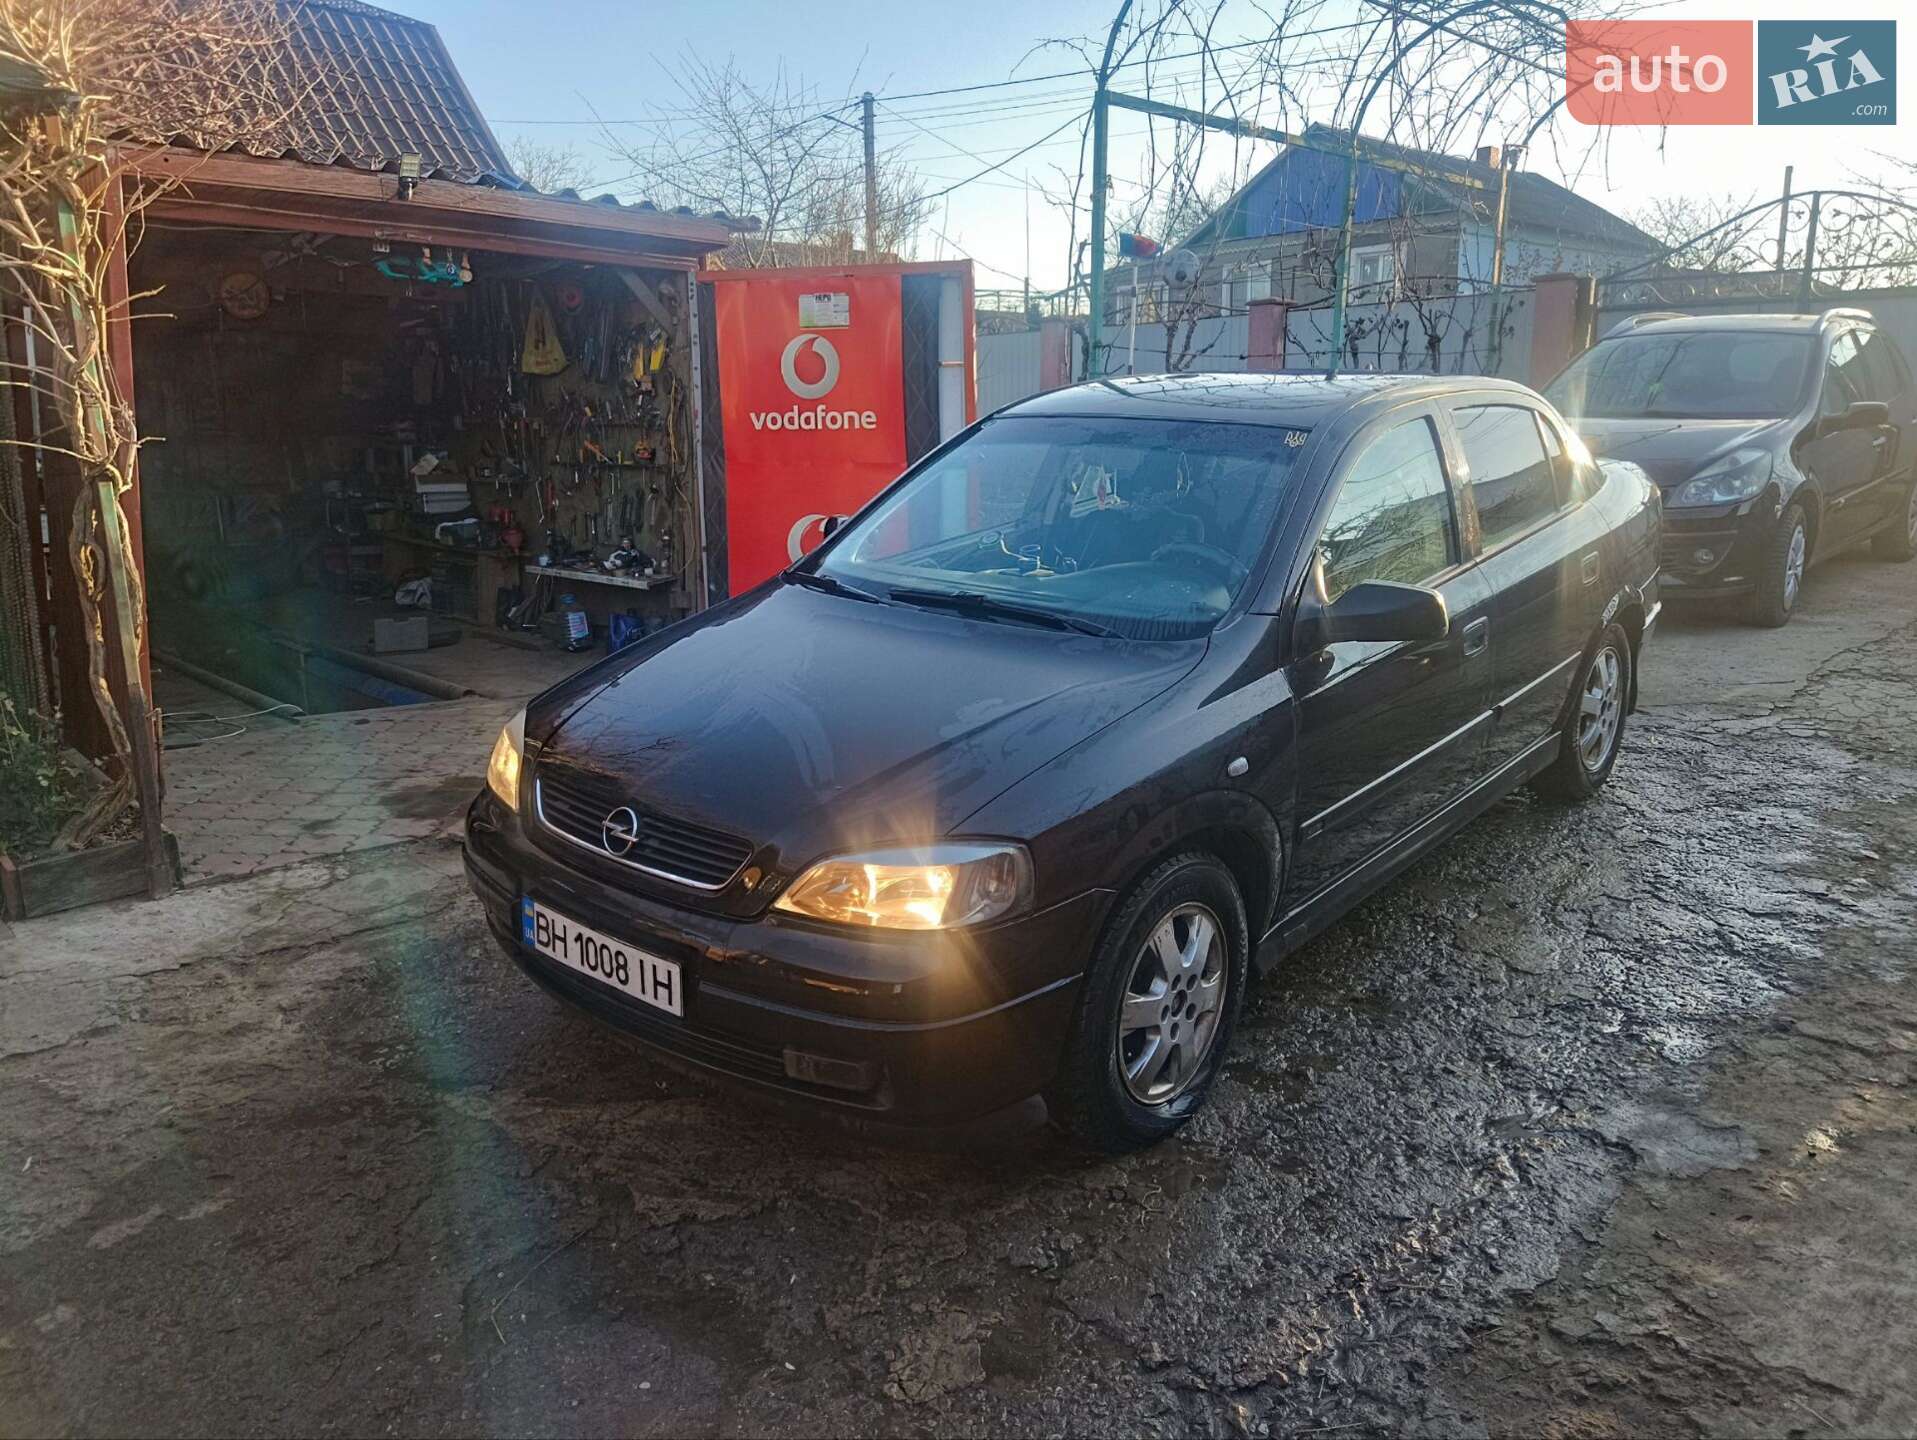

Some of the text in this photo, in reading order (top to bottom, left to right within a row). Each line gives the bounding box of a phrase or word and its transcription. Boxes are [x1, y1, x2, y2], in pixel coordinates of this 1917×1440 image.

[750, 405, 877, 431] vodafone
[535, 911, 673, 1006] BH 1008 IH
